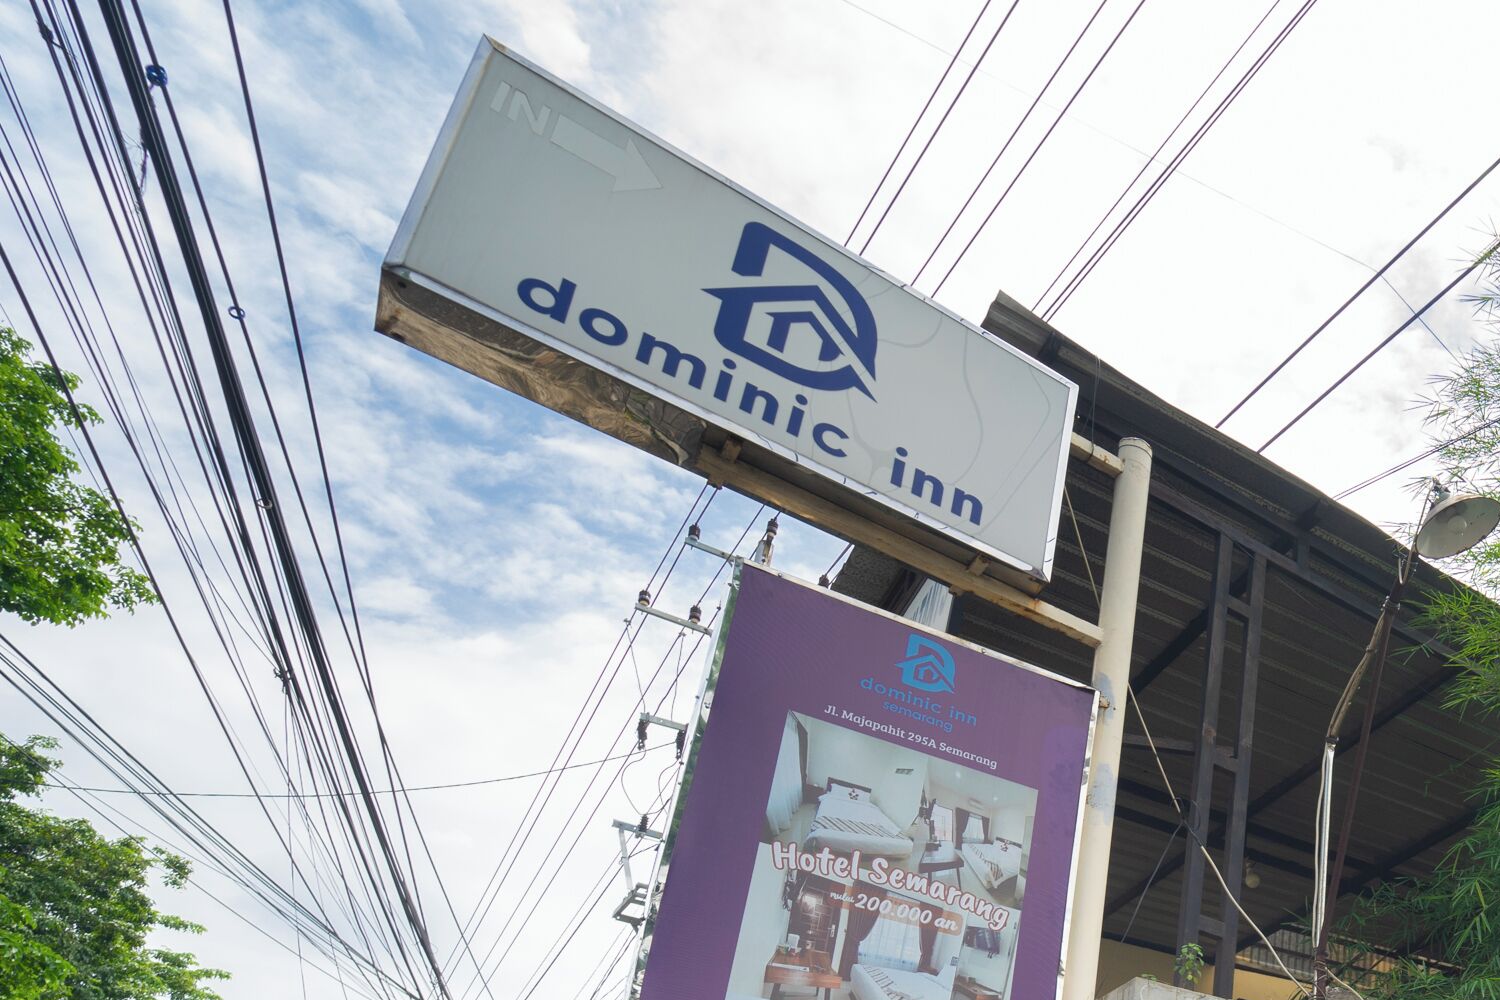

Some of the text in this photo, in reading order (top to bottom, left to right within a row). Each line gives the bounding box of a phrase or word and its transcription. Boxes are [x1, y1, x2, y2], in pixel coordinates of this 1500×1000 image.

[489, 80, 551, 136] IN
[516, 277, 984, 526] dominic inn
[860, 677, 977, 727] dominic inn
[882, 700, 953, 733] semarang
[824, 705, 998, 770] Jl. Majapahit 295A Semarang
[771, 841, 1010, 931] Hotel Semarang
[830, 891, 958, 931] mulai 200.000 an
